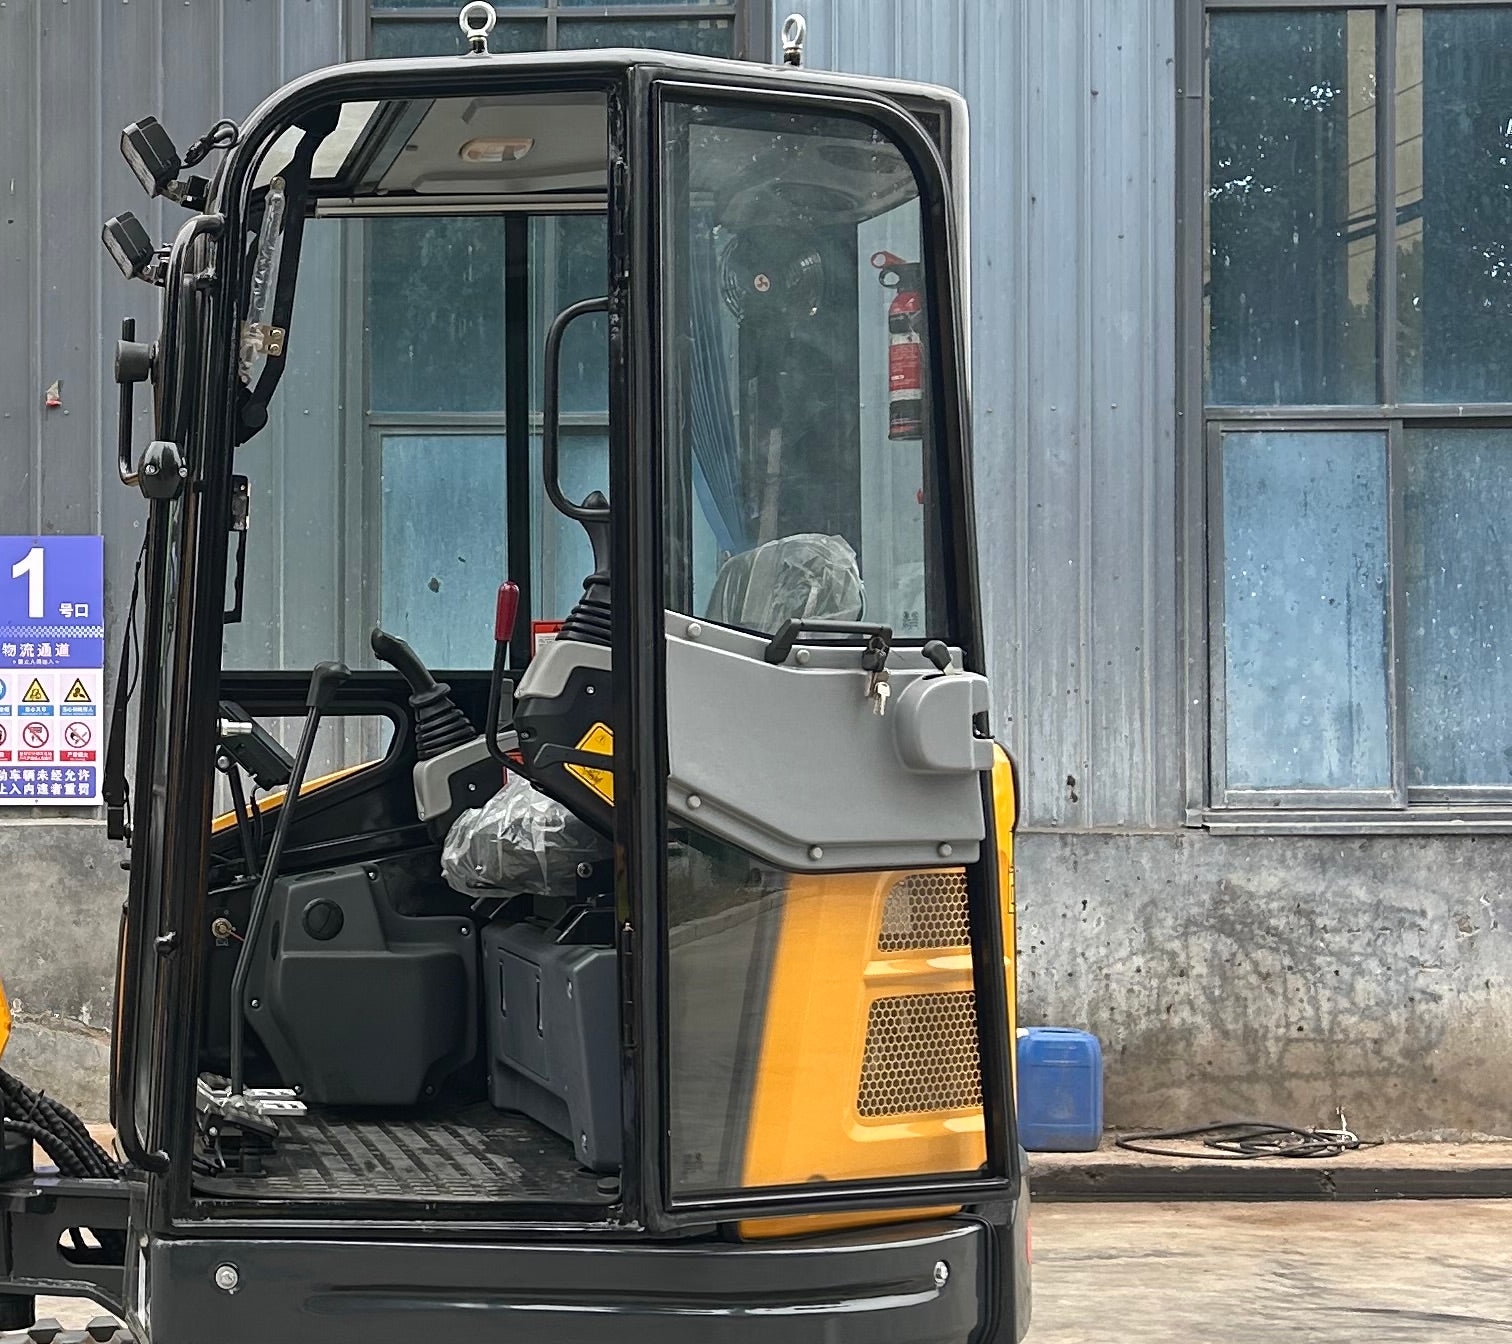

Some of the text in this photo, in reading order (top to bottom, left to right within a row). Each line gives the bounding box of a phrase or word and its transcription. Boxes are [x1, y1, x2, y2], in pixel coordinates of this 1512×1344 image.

[11, 547, 89, 618] 1 号口
[1, 642, 70, 658] 物流通道
